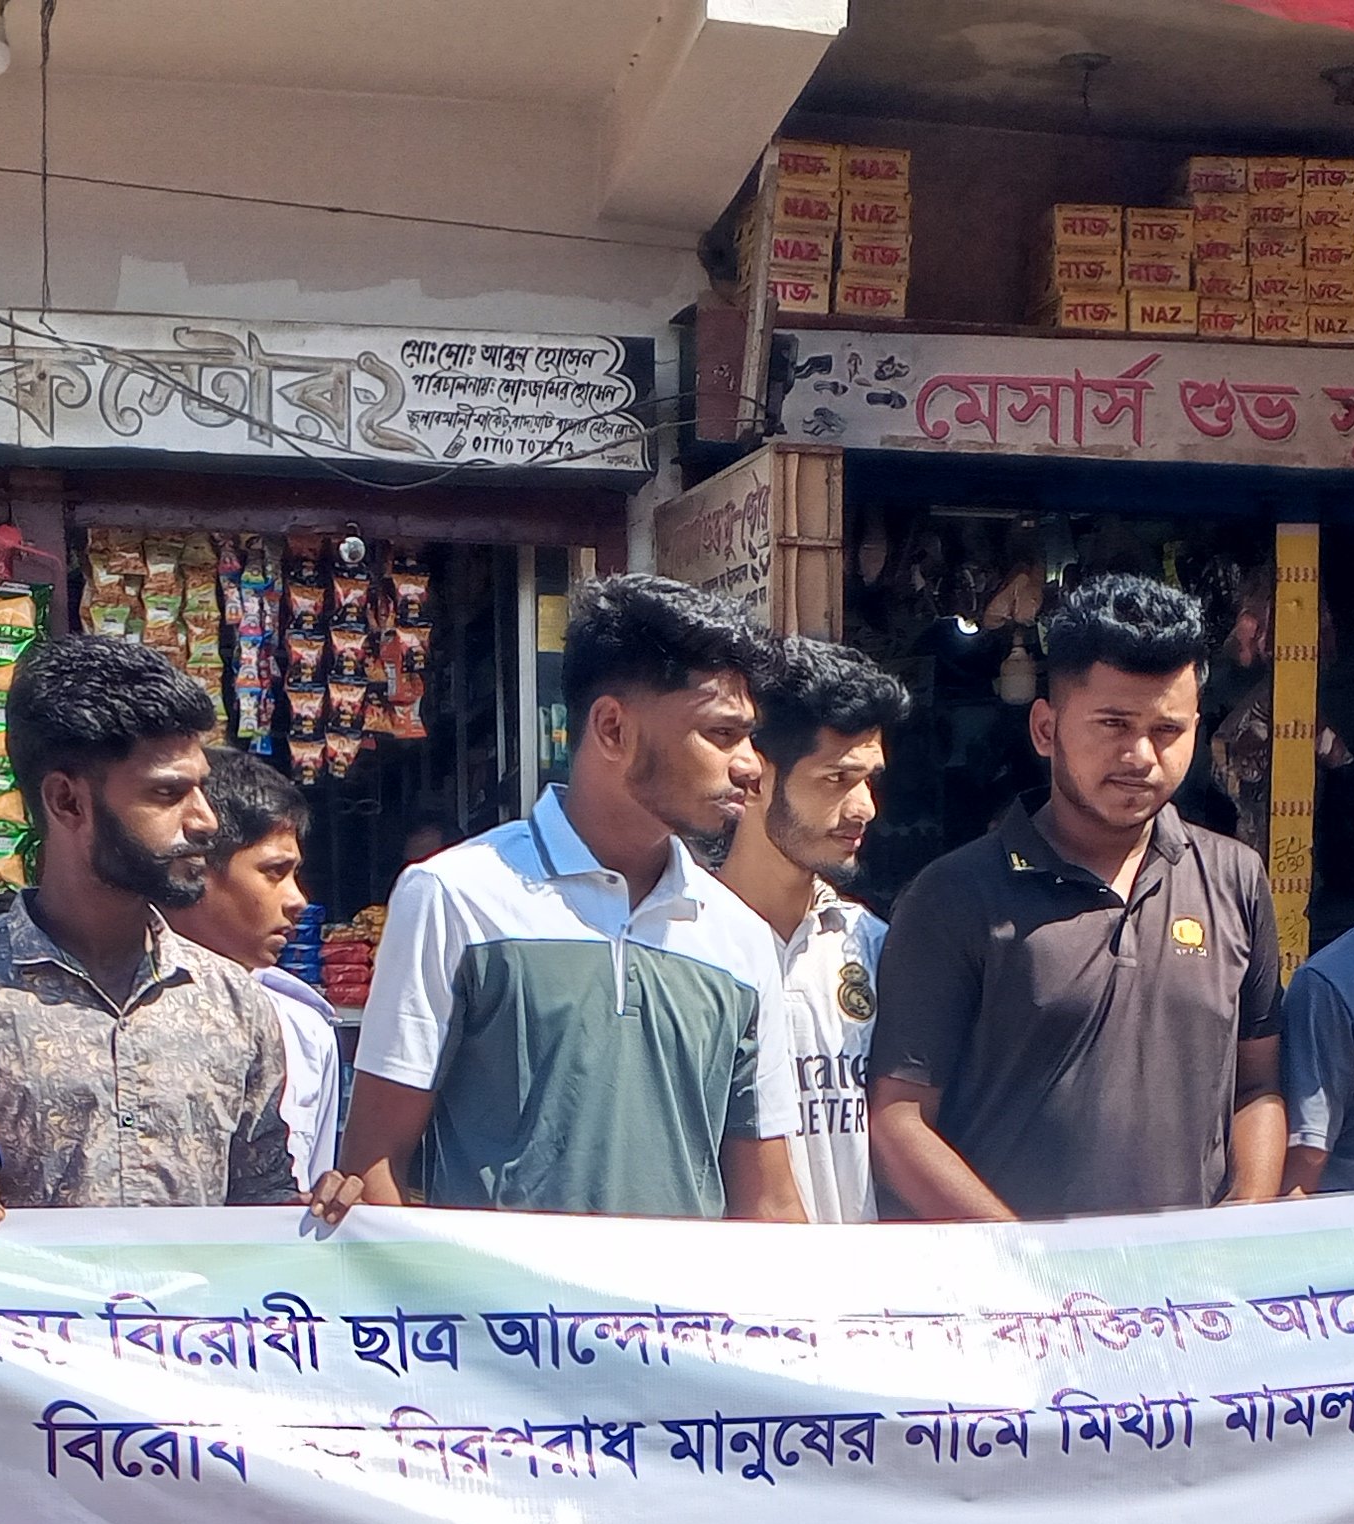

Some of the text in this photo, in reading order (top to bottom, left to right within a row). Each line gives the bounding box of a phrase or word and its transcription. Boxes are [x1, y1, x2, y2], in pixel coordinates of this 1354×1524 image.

[851, 203, 897, 224] NAZ
[774, 239, 819, 261] NAZ
[1141, 306, 1183, 324] NAZ
[1314, 318, 1350, 334] NAZ
[916, 354, 1161, 446] মেসার্স
[1179, 378, 1300, 440] শুভ
[473, 436, 513, 455] 01710
[96, 1292, 326, 1373] বিরোধী
[341, 1307, 465, 1377] ছাত্র
[658, 1411, 885, 1487] মানুষের
[896, 1402, 1035, 1463] নামে
[1046, 1387, 1198, 1454] মিথ্যা
